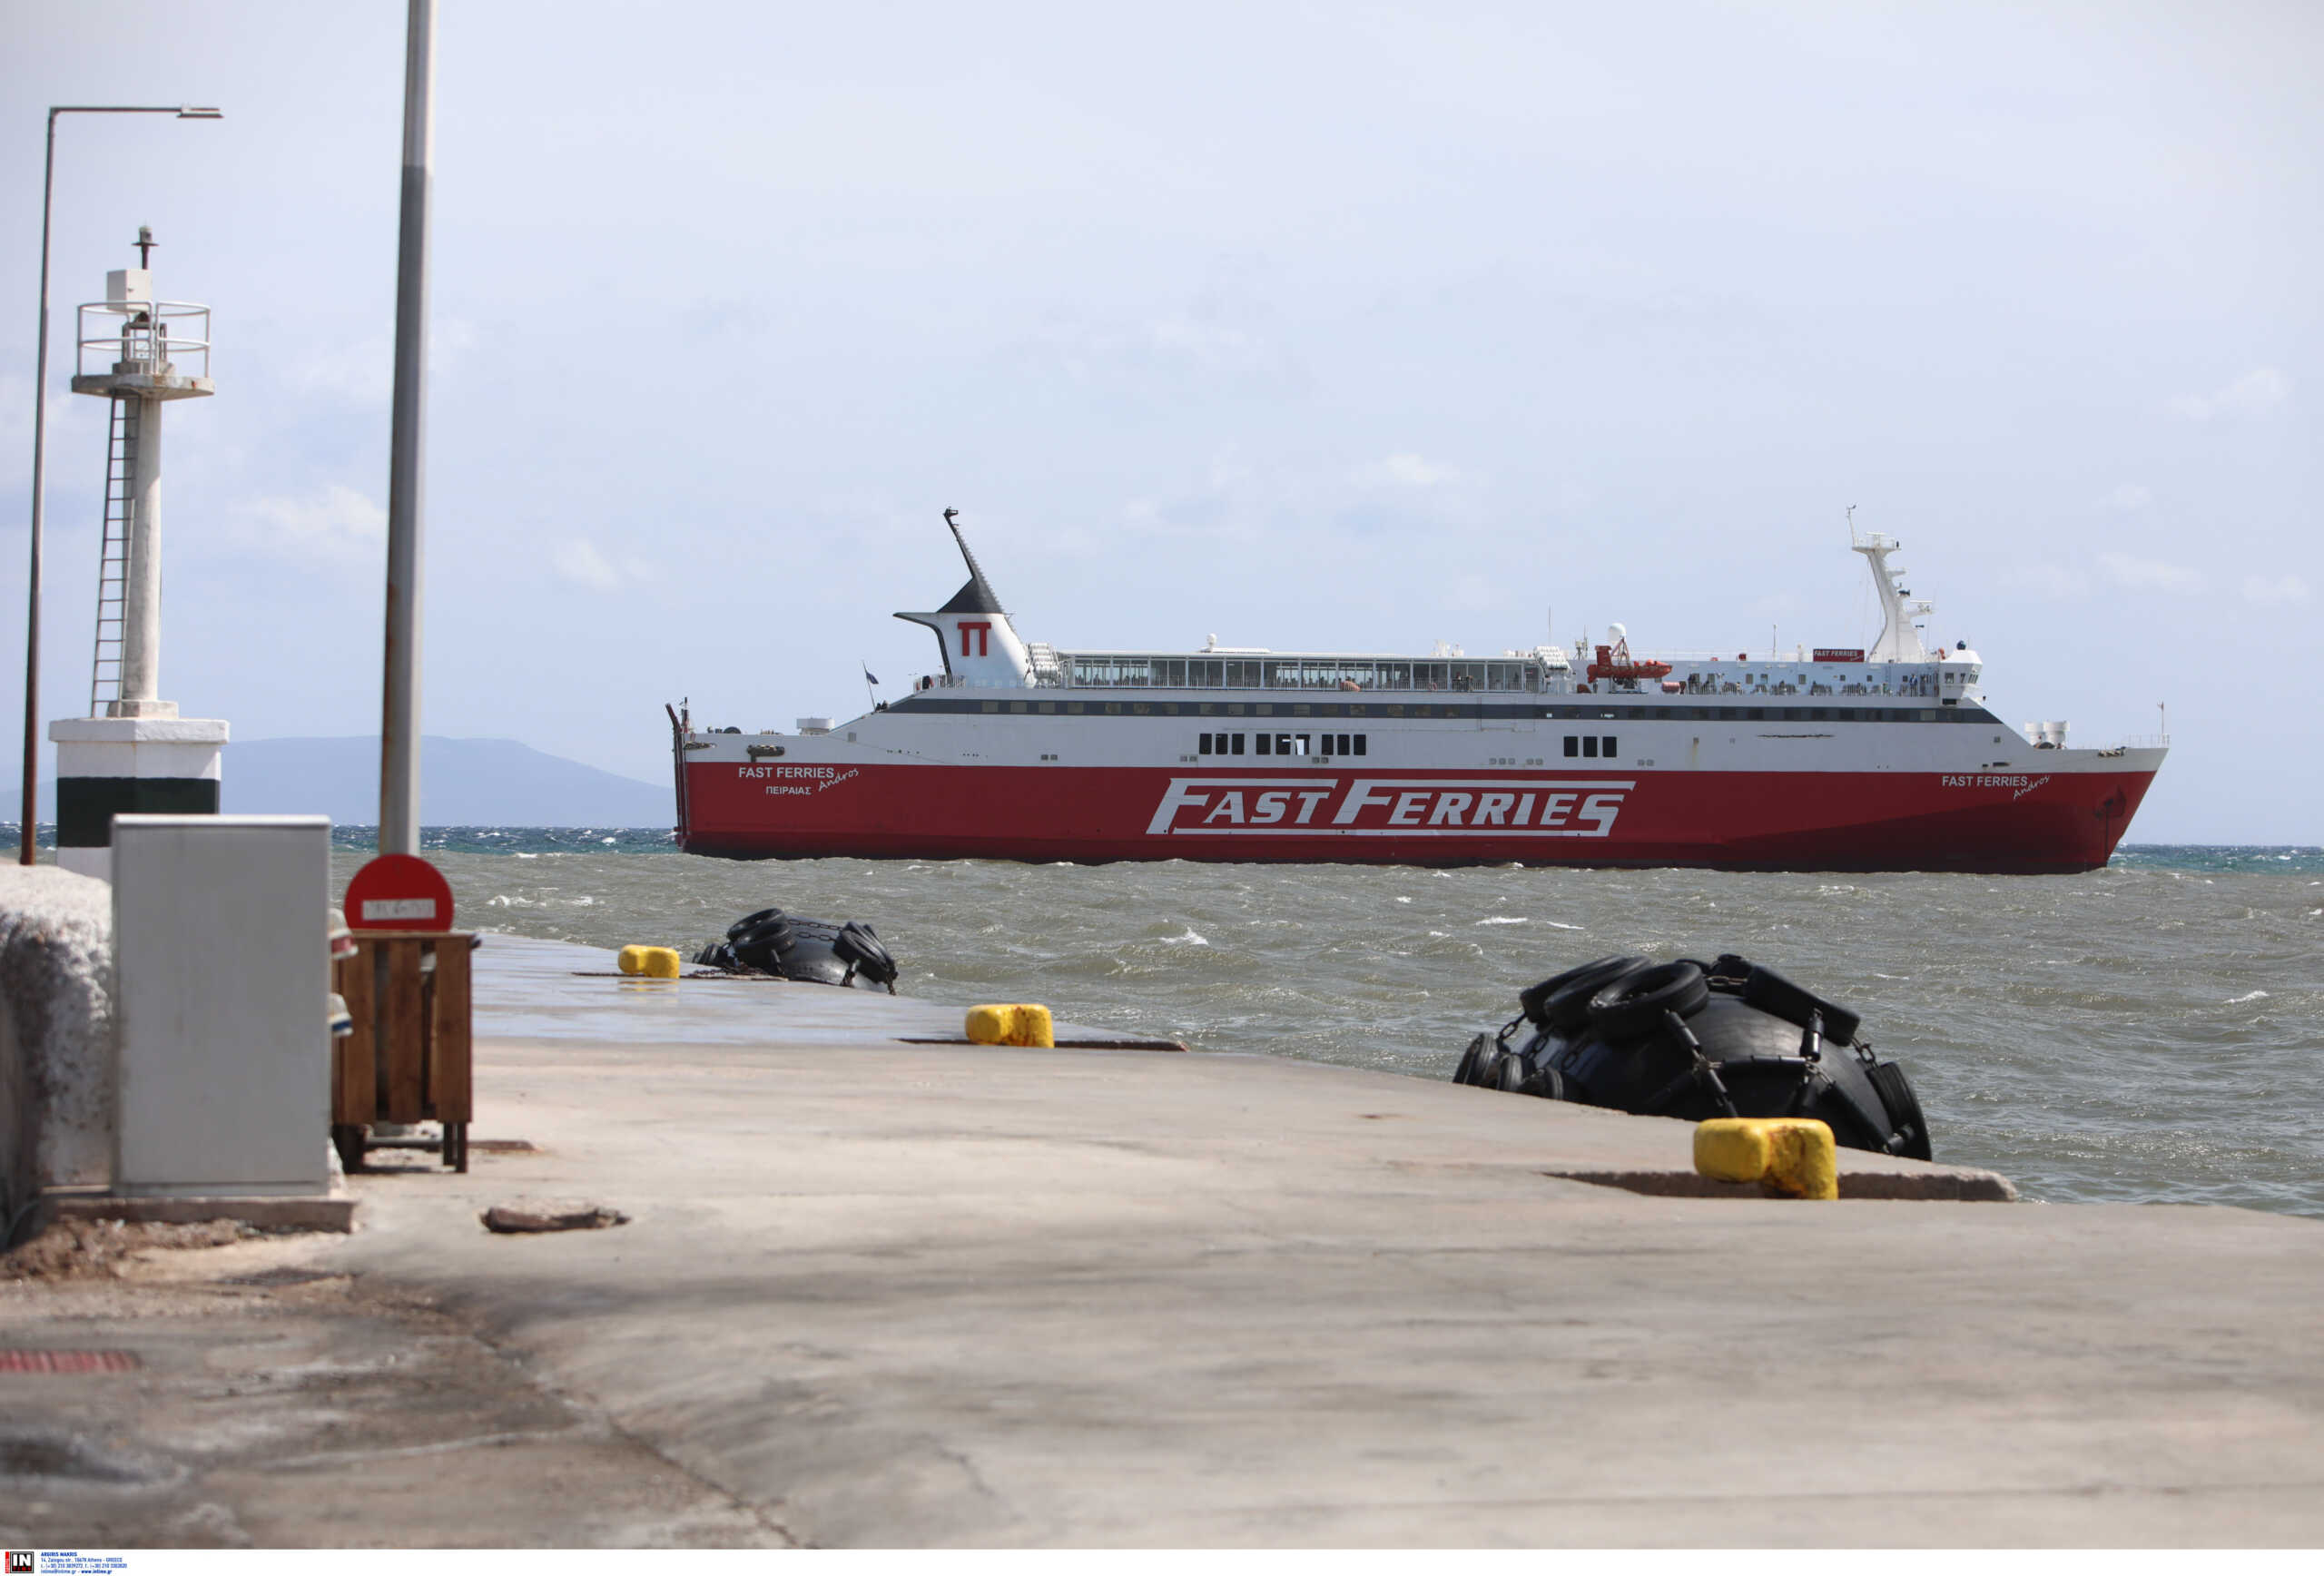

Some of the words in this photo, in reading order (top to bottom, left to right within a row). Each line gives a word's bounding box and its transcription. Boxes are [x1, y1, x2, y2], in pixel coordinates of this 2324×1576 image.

[738, 767, 773, 778] FAST
[777, 767, 834, 779] FERRIES
[818, 768, 859, 792] Andros
[1942, 775, 1974, 786] FAST
[1976, 775, 2028, 787] FERRIES
[765, 785, 812, 795] ΠΕΙΡΑΙΑΣ
[2013, 774, 2051, 799] Andros
[1146, 778, 1338, 834] FAST
[1332, 778, 1636, 837] FERRIES
